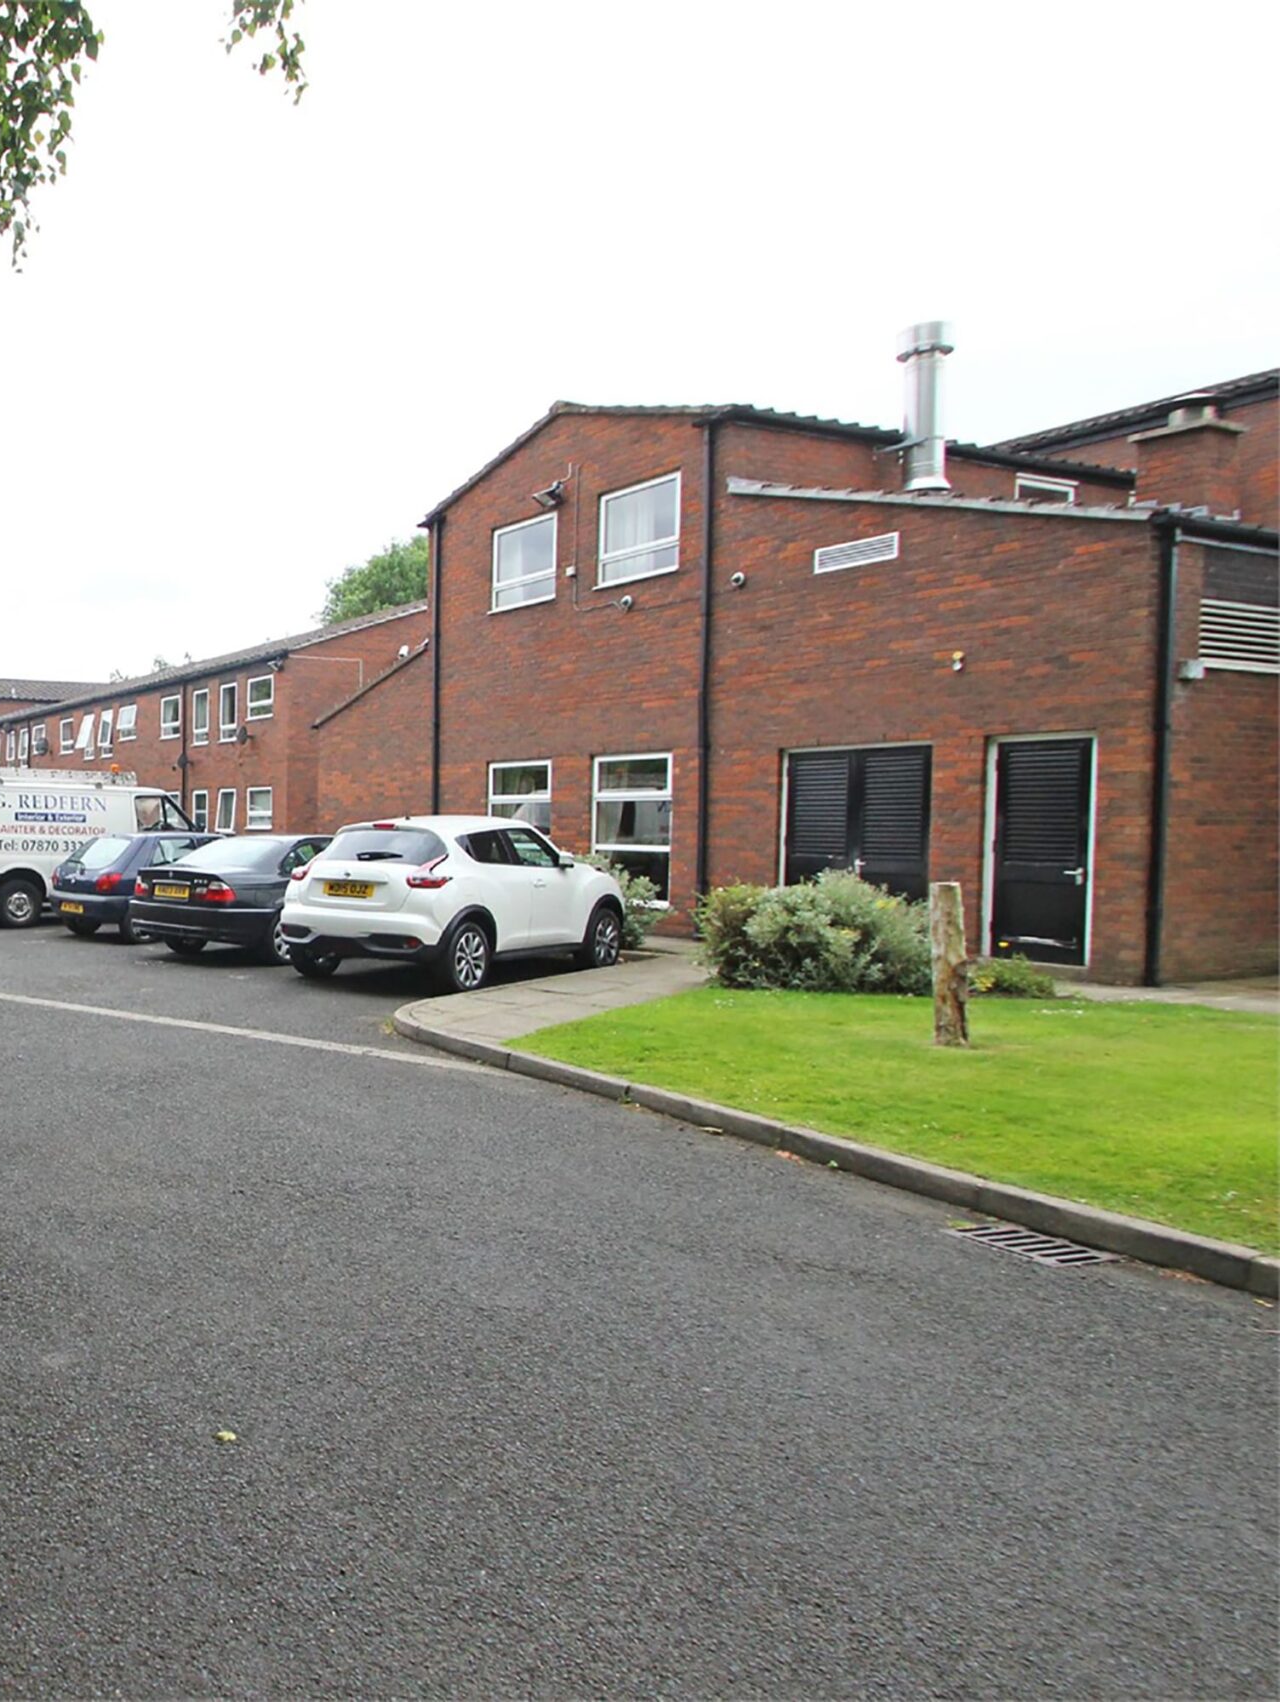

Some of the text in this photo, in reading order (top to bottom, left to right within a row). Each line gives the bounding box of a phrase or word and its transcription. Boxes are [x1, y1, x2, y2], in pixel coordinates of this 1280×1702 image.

[18, 794, 107, 811] REDFERN
[38, 825, 46, 835] &
[21, 840, 59, 852] 07870
